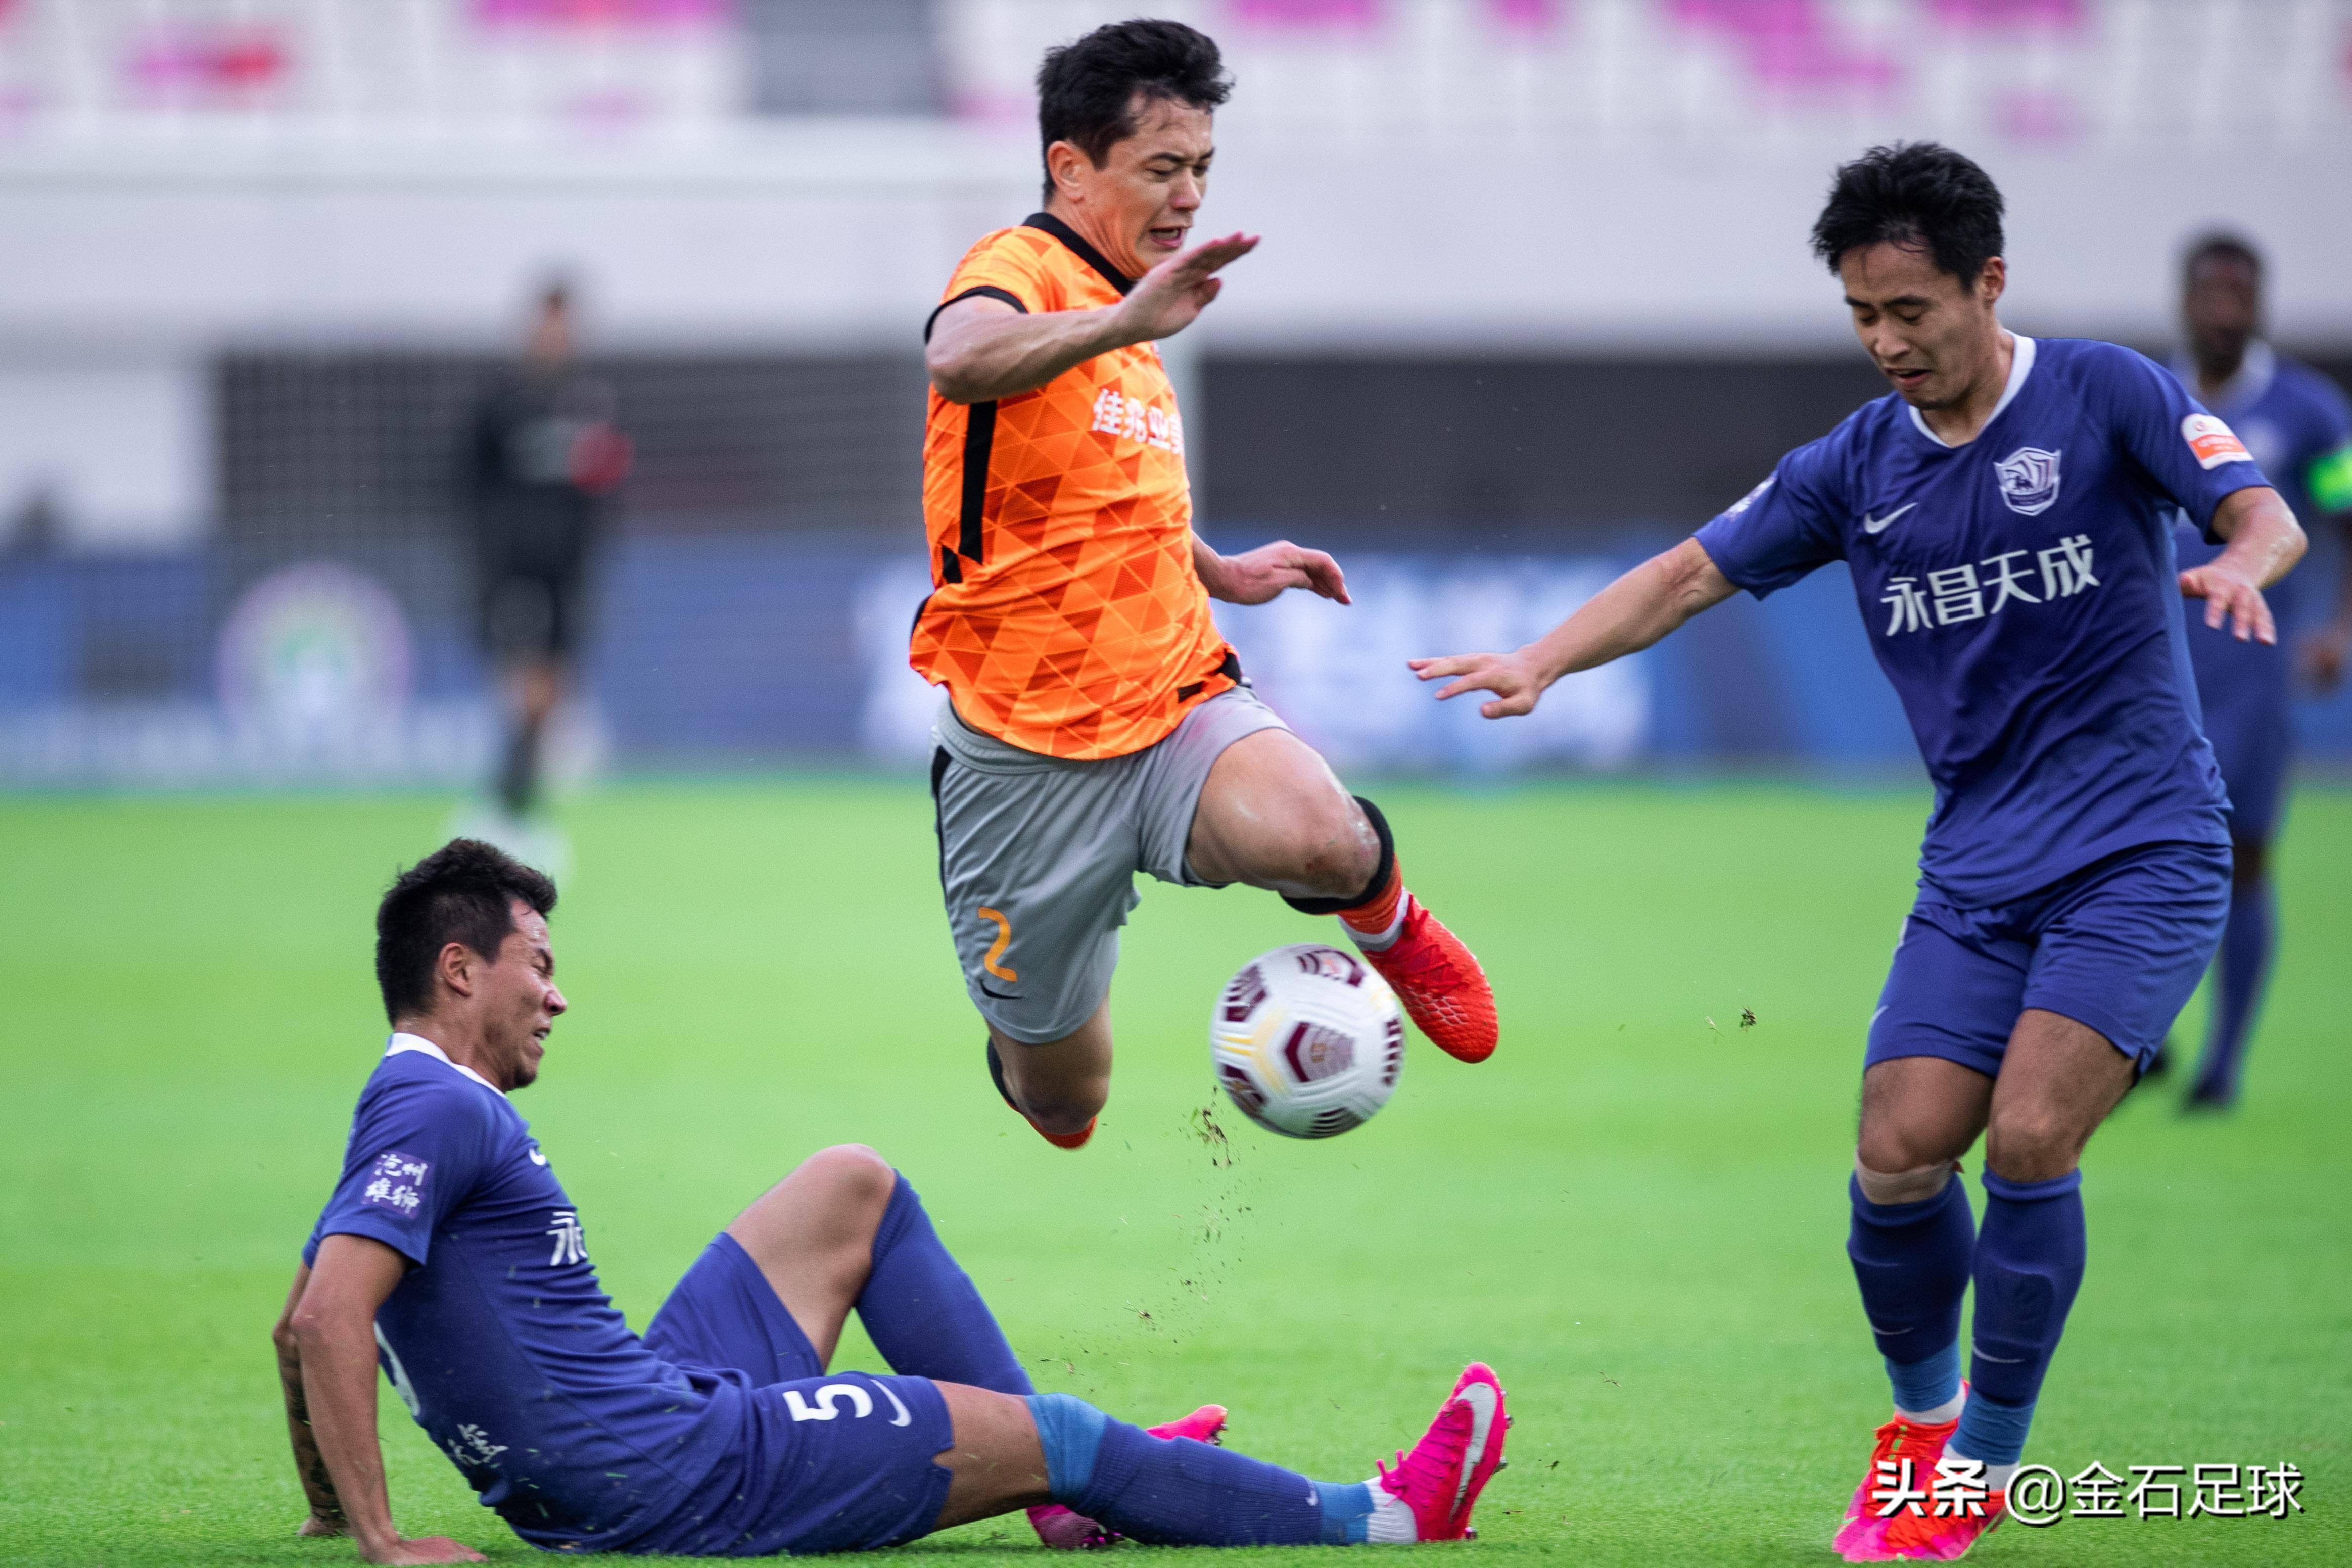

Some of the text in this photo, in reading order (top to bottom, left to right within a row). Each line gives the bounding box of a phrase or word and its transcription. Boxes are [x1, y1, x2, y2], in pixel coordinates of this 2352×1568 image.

[1880, 534, 2100, 636] 永昌天成
[977, 906, 1018, 982] 2
[782, 1384, 873, 1421] 5
